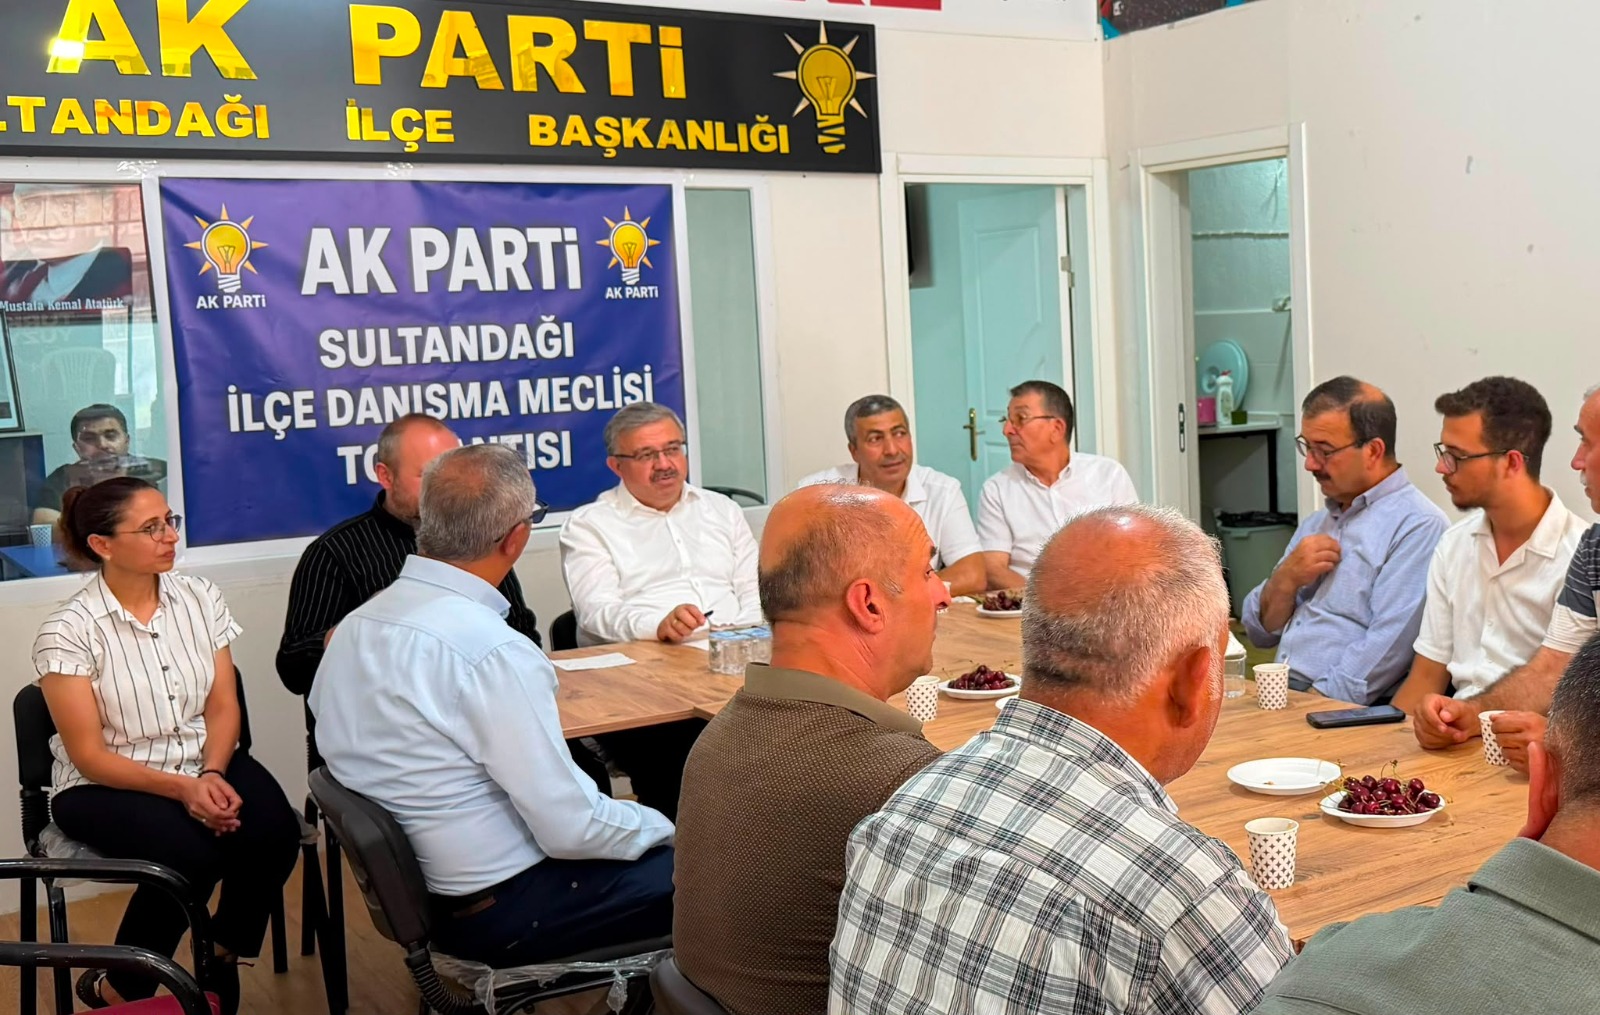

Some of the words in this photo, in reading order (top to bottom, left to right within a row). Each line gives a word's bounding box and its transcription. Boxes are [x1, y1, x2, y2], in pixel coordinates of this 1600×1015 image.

[46, 0, 258, 80] AK
[0, 93, 270, 139] TANDAĞI
[345, 98, 455, 152] İLÇE
[528, 114, 790, 158] BAŞKANLIĞI
[301, 227, 398, 295] AK
[47, 299, 82, 311] Kemal
[196, 295, 219, 309] AK
[605, 286, 623, 299] AK
[318, 314, 575, 369] SULTANDAĞI
[227, 384, 317, 441] İLÇE
[518, 363, 654, 415] MECLİSİ
